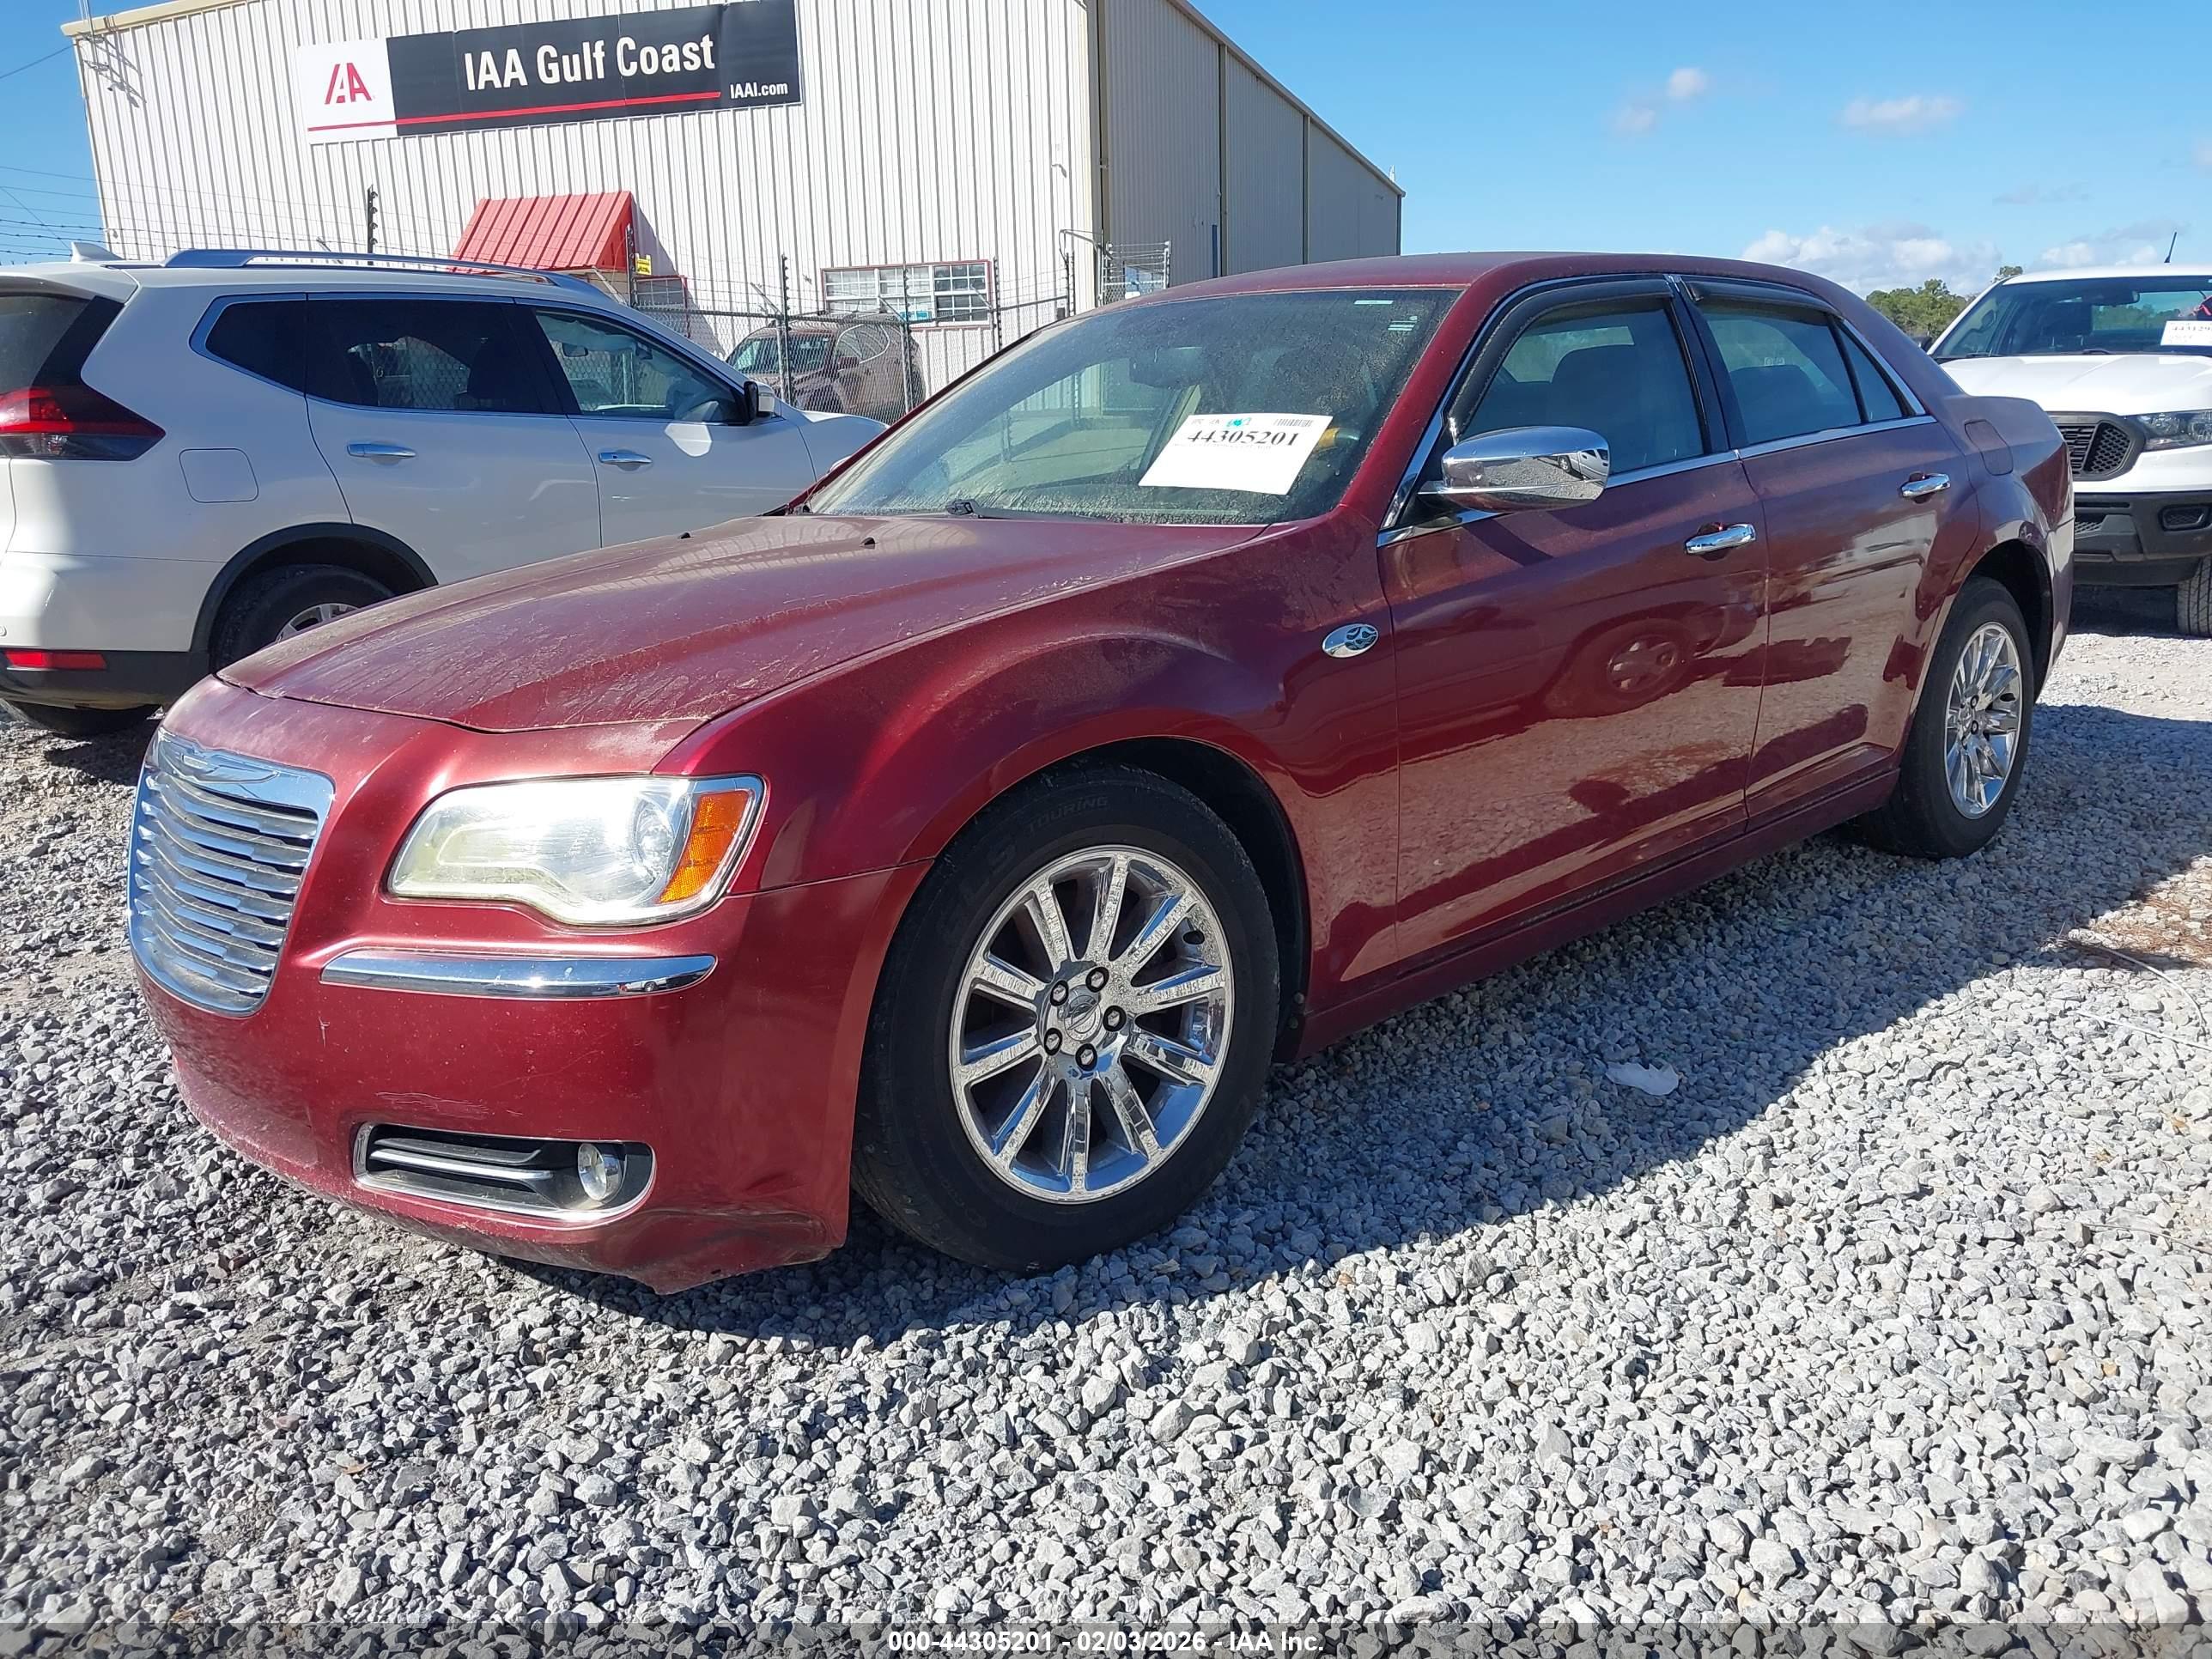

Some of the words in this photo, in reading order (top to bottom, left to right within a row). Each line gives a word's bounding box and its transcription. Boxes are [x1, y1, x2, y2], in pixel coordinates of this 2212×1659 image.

[465, 48, 528, 91] IAA
[536, 40, 605, 84] Gulf
[617, 33, 715, 77] Coast
[730, 82, 788, 100] IAAI.com
[1188, 429, 1300, 447] 44305201
[1027, 795, 1109, 833] TOURING
